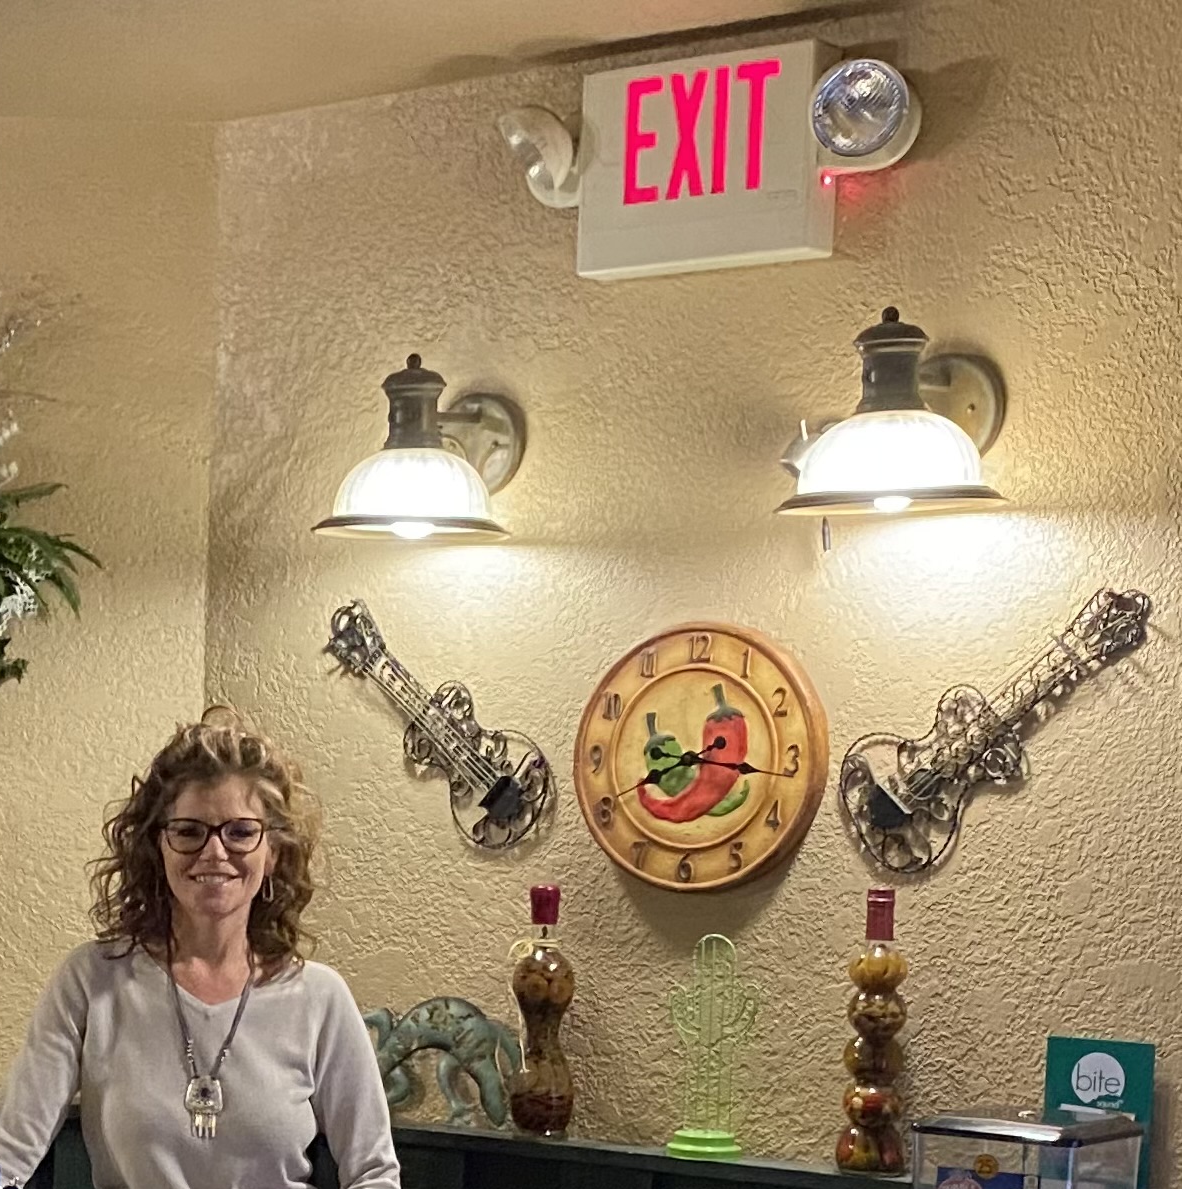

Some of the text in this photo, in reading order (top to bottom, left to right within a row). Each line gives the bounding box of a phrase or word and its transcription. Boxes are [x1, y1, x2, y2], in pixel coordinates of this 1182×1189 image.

[622, 57, 782, 206] EXIT
[688, 634, 714, 663] 12
[742, 647, 752, 679] 1
[640, 650, 659, 678] 11
[602, 690, 622, 721] 10
[771, 687, 788, 718] 2
[590, 744, 605, 774] 9
[783, 744, 801, 778] 3
[599, 796, 615, 825] 8
[765, 800, 782, 832] 4
[632, 840, 651, 869] 7
[677, 853, 695, 883] 6
[729, 841, 744, 871] 5
[1075, 1062, 1121, 1094] bite
